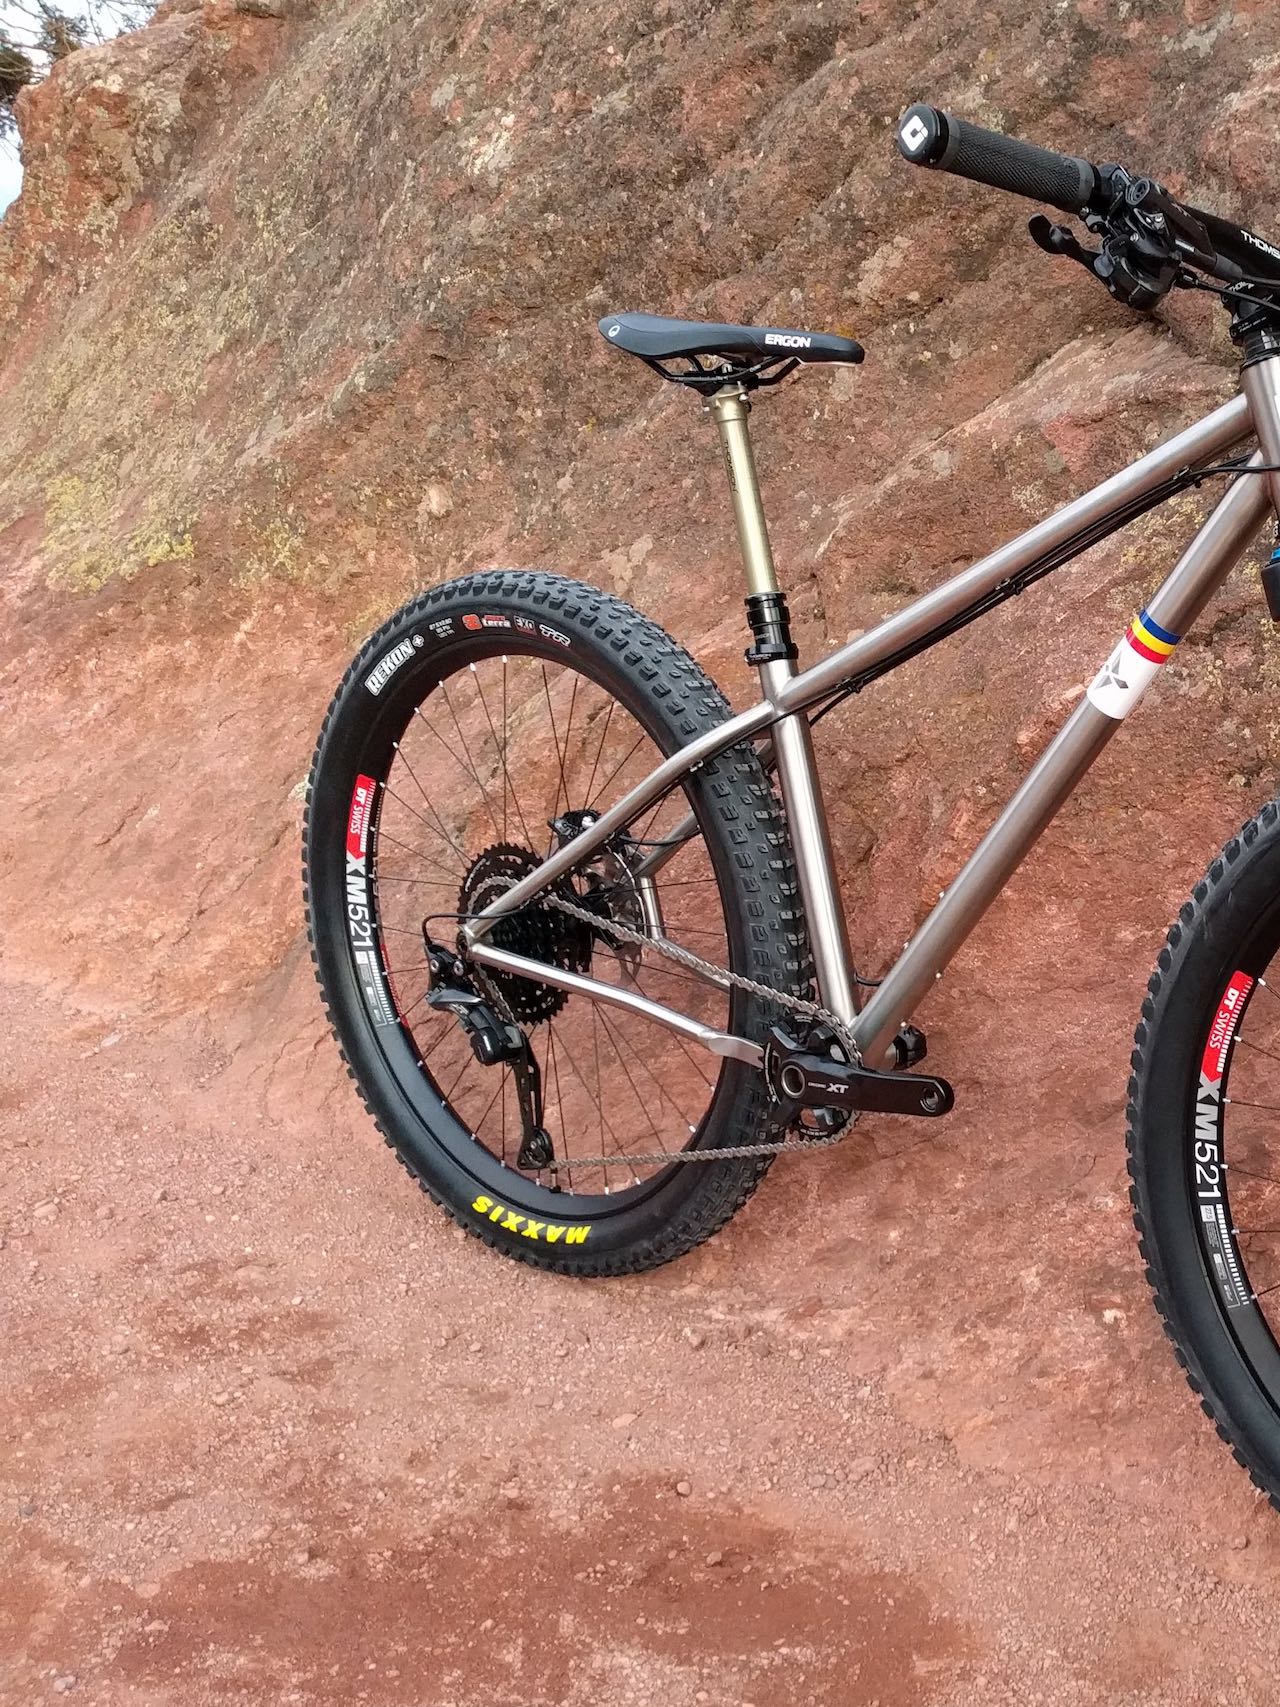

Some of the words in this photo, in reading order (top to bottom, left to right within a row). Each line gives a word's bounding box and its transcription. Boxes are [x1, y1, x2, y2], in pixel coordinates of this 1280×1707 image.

[764, 333, 812, 348] ERGON
[364, 637, 416, 696] REKON
[354, 787, 367, 805] DT
[349, 804, 364, 835] SWISS
[346, 856, 374, 947] XM521
[1223, 986, 1240, 1010] DT
[1208, 1010, 1230, 1050] SWISS
[826, 1082, 849, 1094] XT
[1194, 1070, 1223, 1200] XM521
[471, 1195, 592, 1245] MAXXIS
